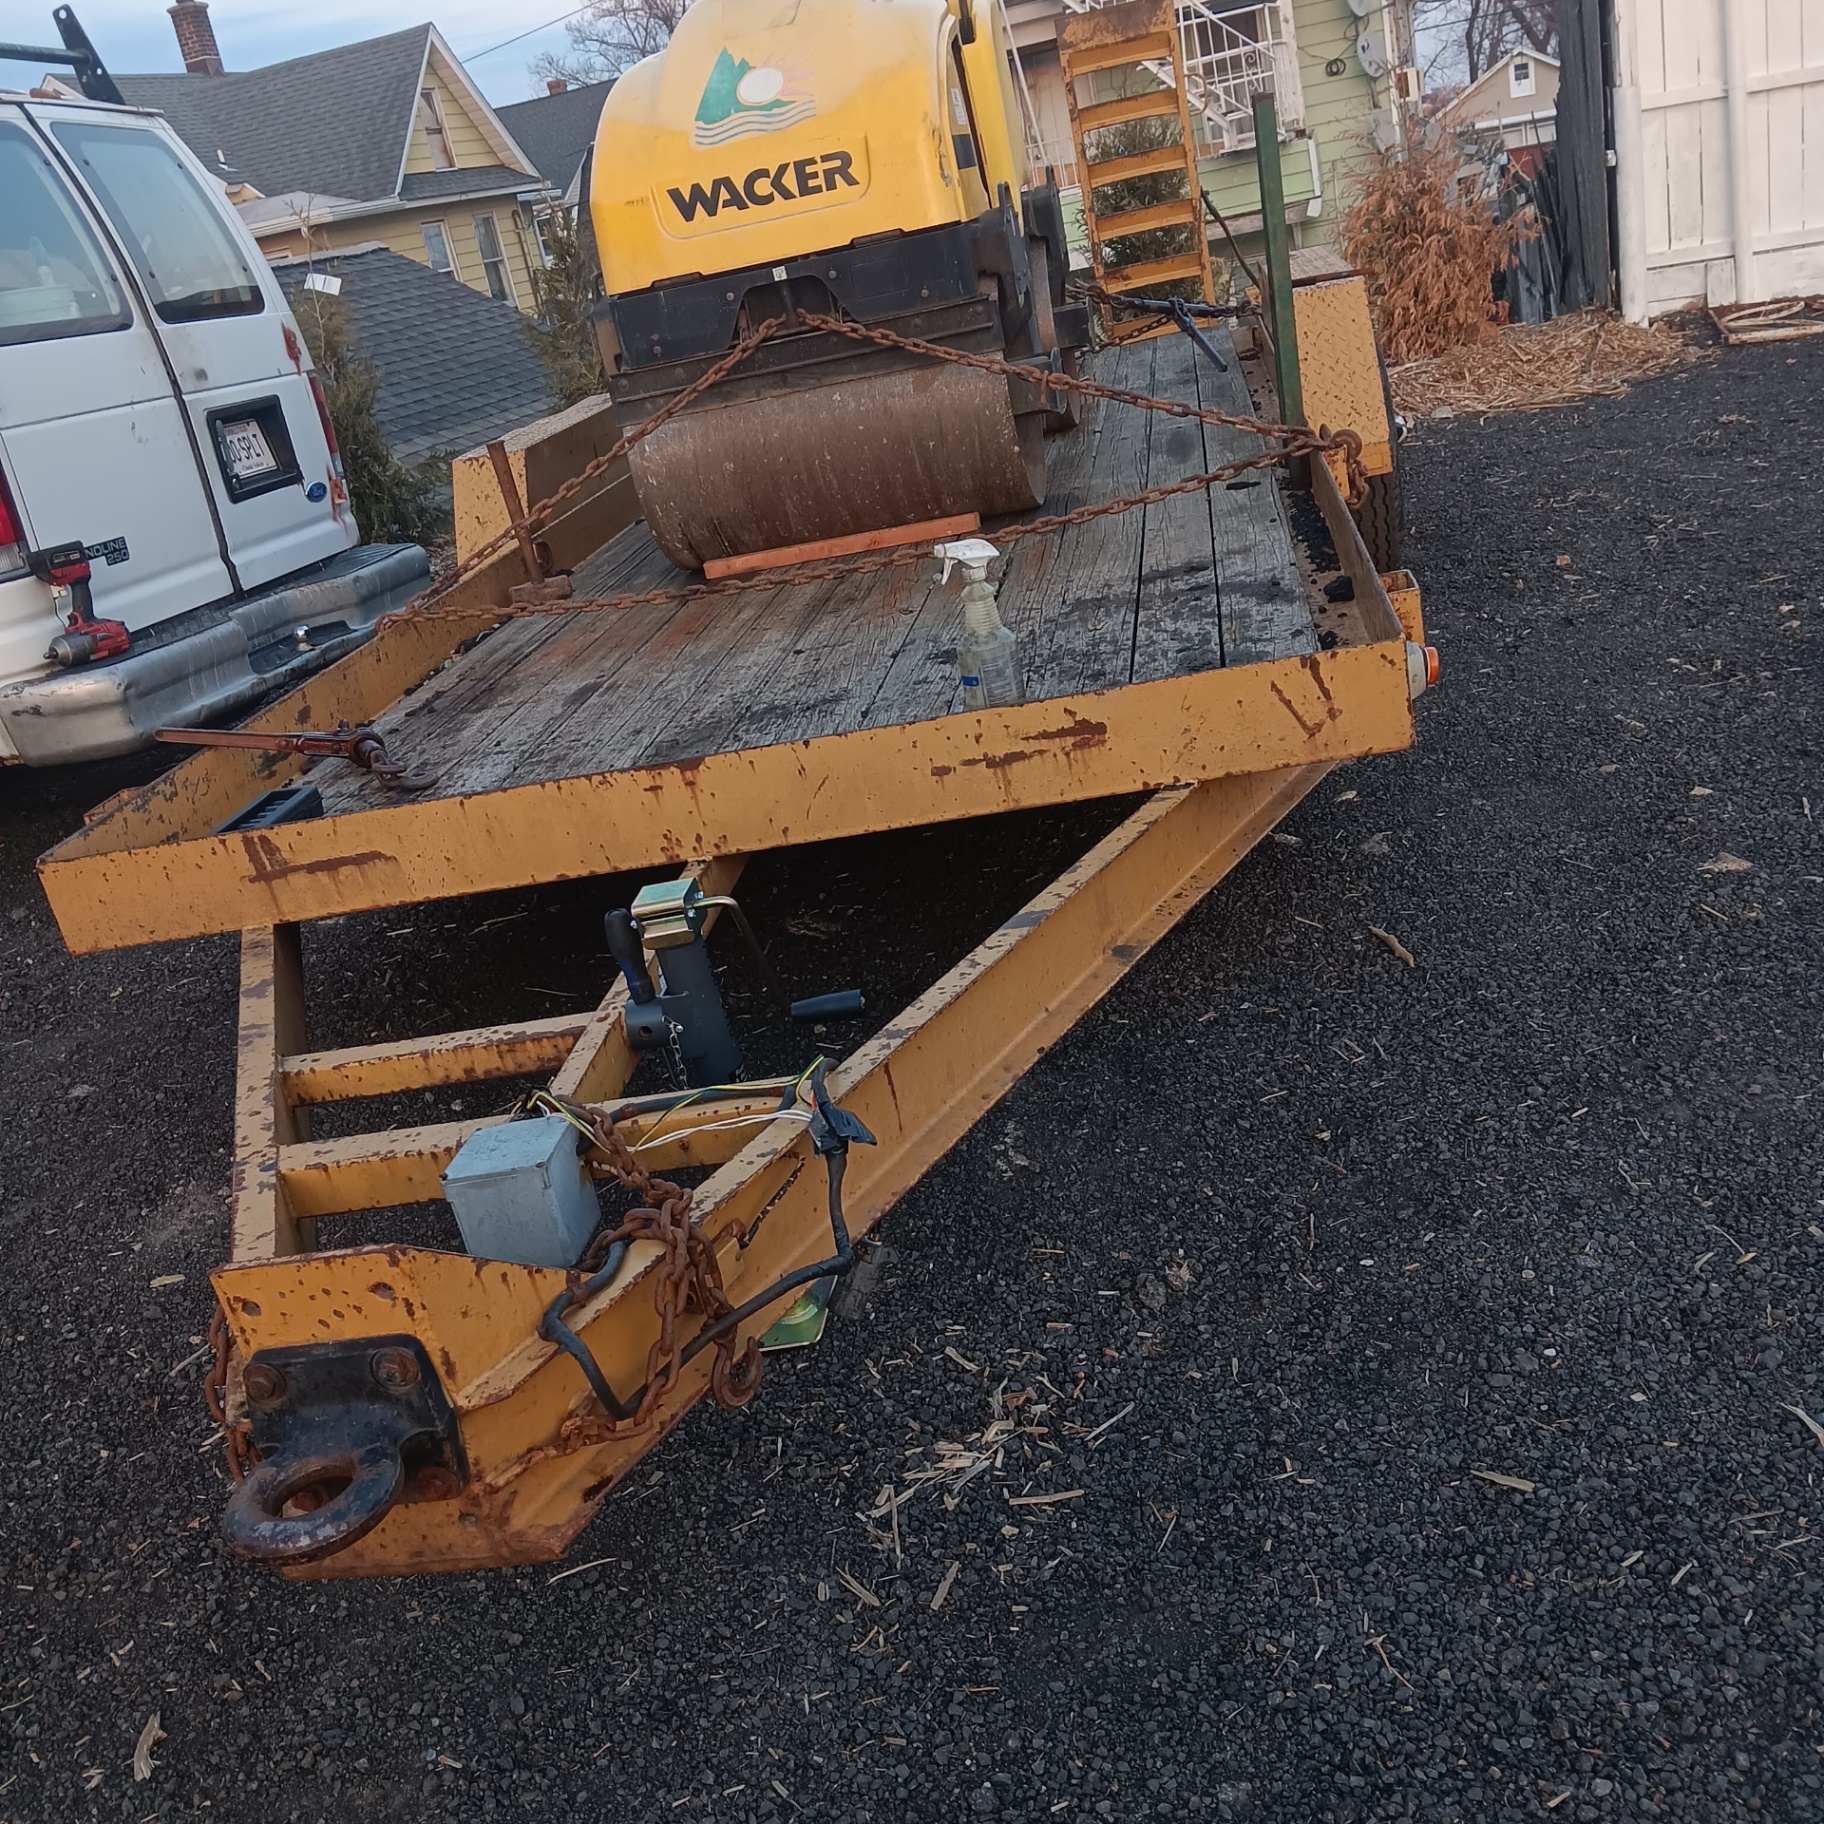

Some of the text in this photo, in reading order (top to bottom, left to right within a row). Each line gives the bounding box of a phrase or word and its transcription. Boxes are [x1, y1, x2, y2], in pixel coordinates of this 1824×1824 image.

[666, 151, 860, 222] WACKER
[85, 538, 126, 559] NOLINE
[106, 549, 129, 564] 250
